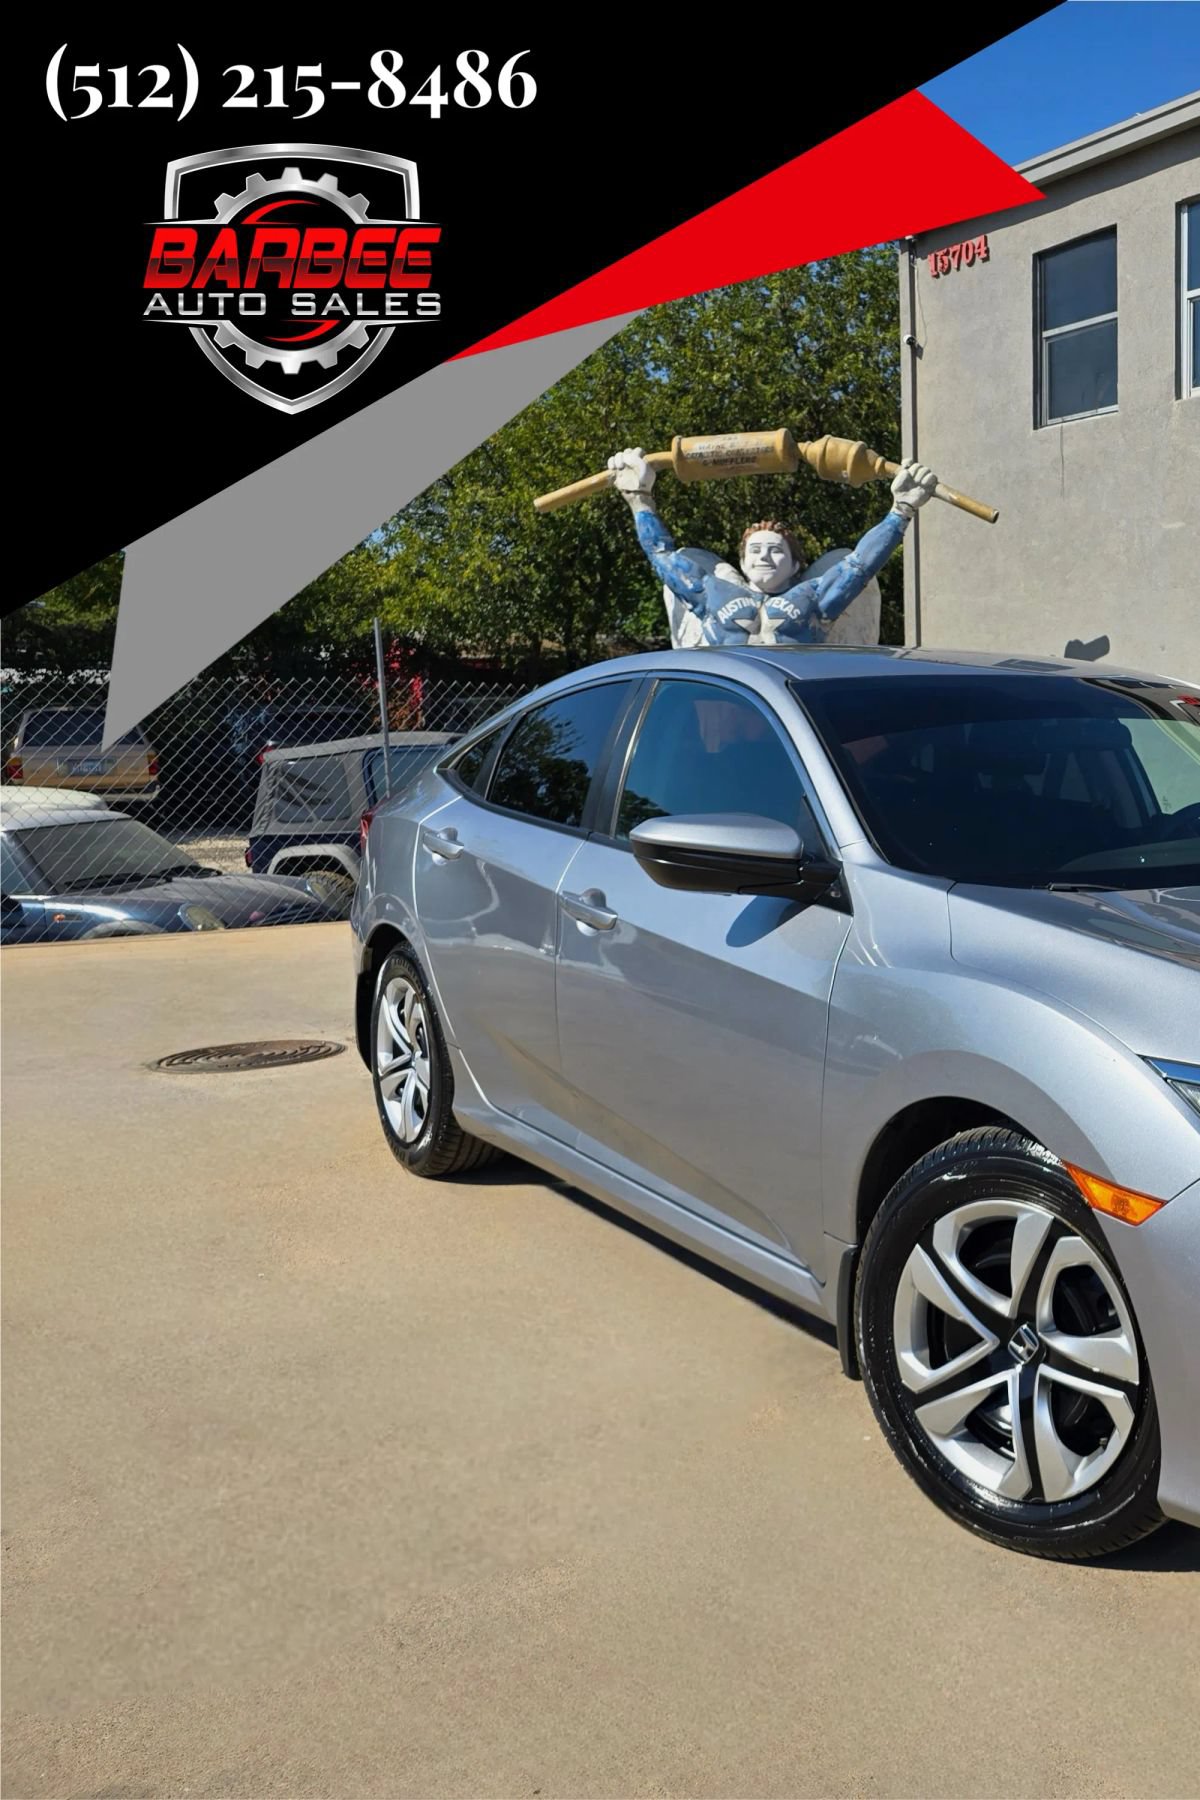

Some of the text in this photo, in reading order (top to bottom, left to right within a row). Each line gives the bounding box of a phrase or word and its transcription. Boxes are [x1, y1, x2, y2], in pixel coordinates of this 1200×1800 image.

[928, 234, 988, 277] 15704
[716, 596, 801, 625] AUSTIN TEXAS
